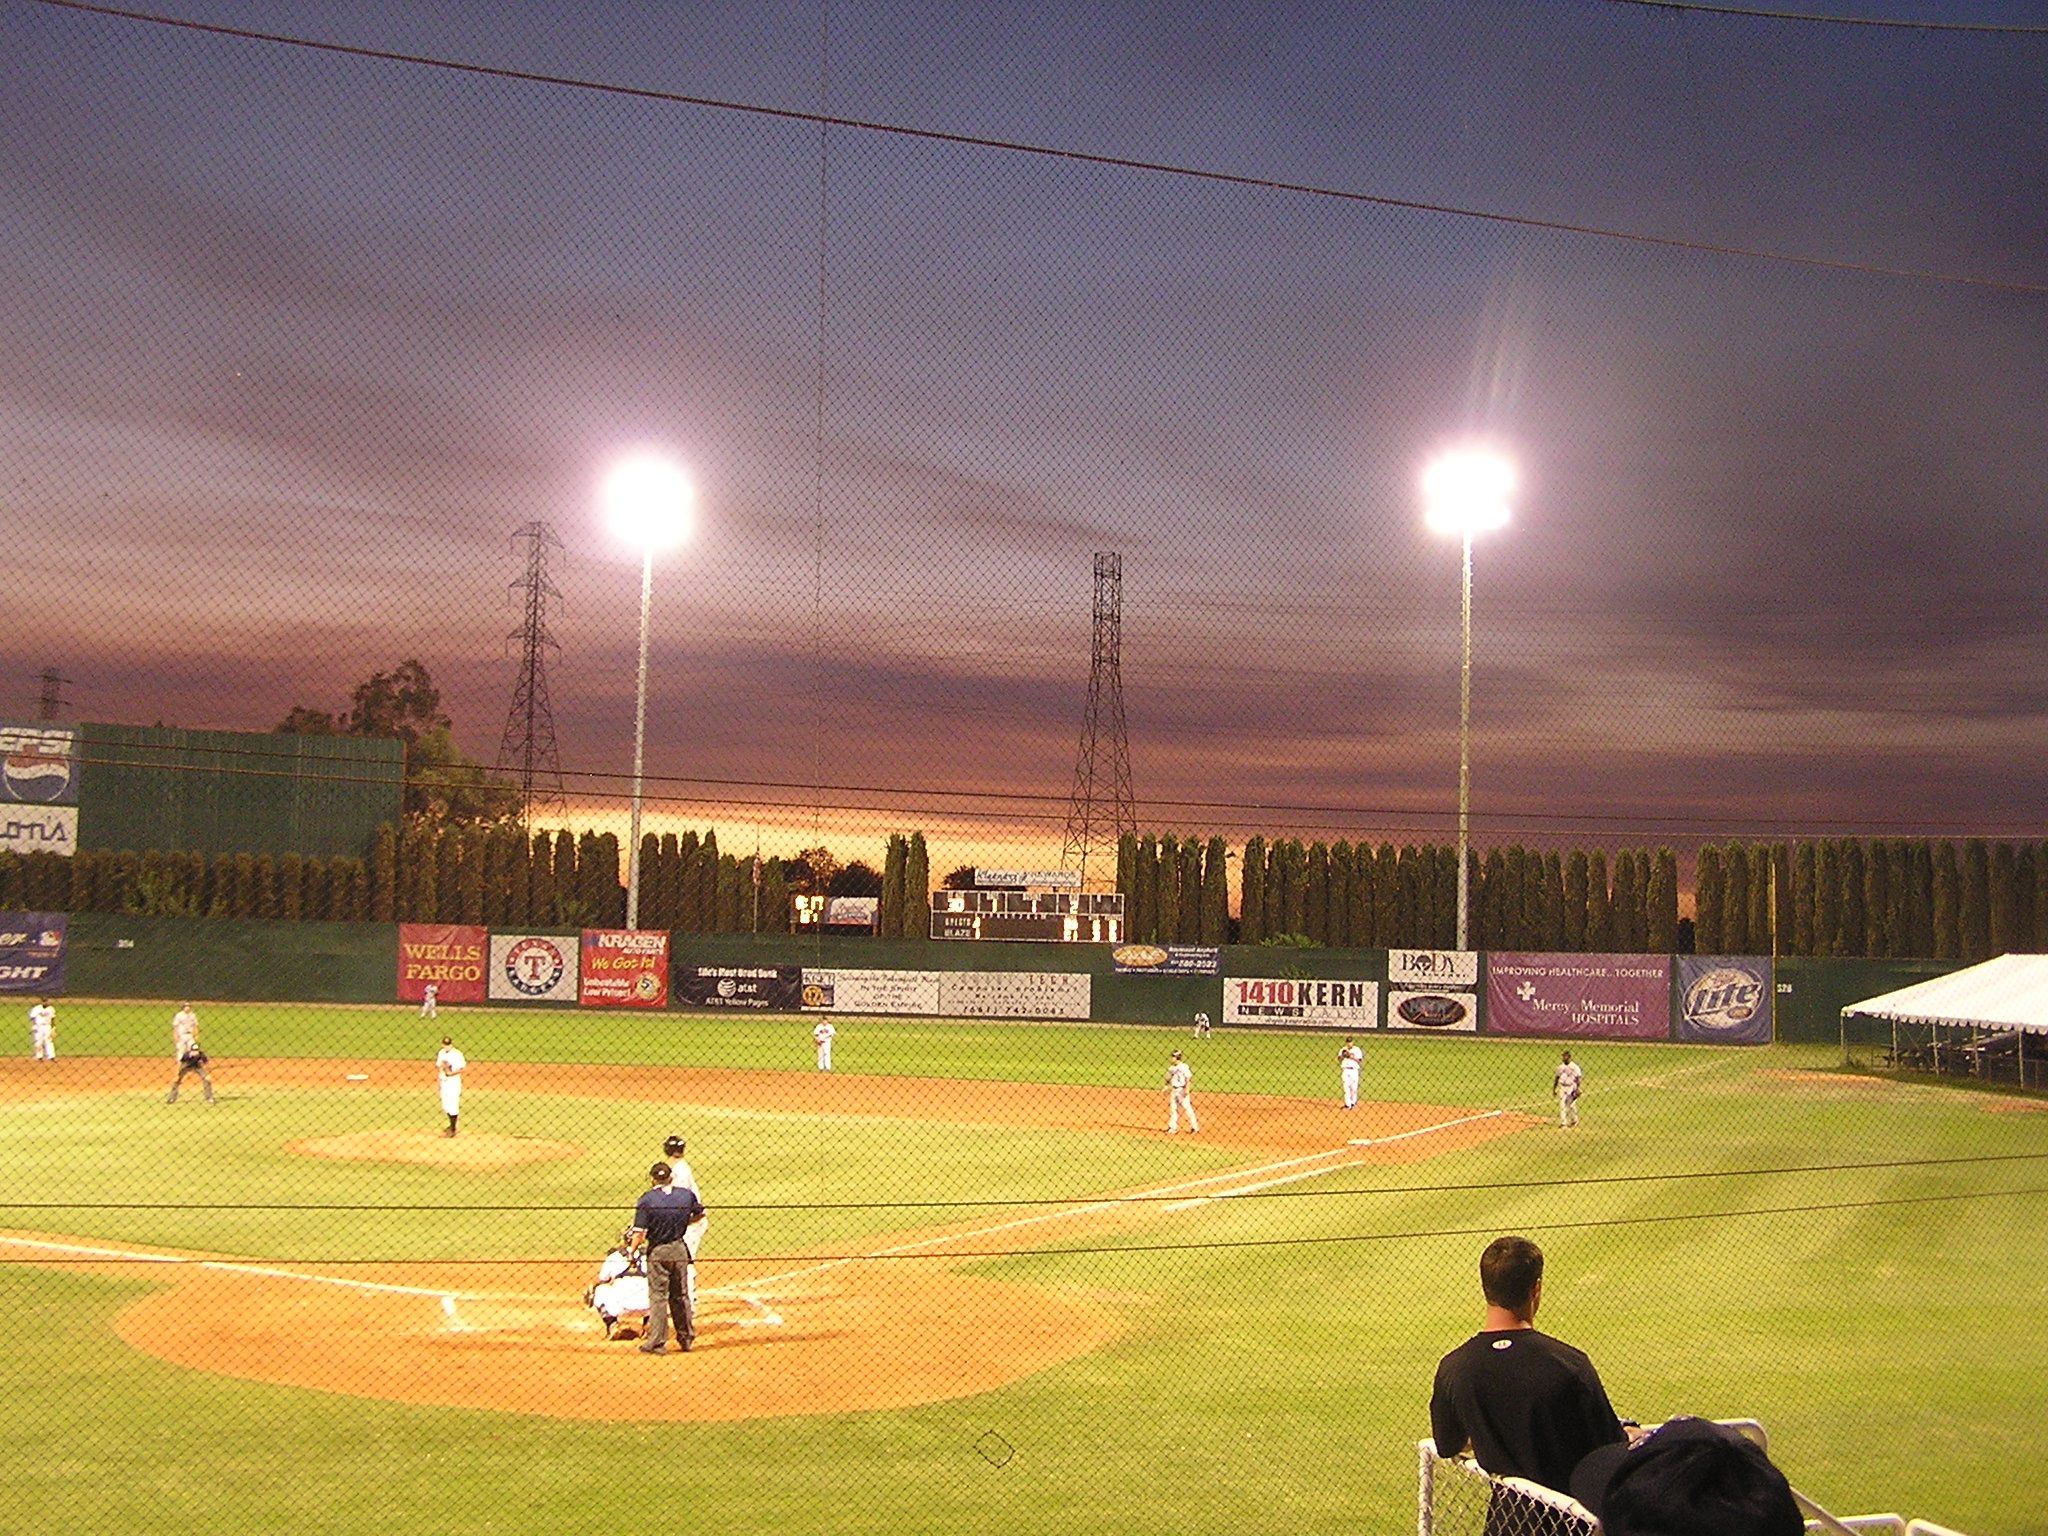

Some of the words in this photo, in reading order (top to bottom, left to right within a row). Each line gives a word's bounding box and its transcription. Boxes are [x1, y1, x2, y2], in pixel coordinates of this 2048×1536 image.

[598, 933, 666, 948] KRAGEN
[404, 943, 481, 961] WELLS
[524, 955, 546, 980] T
[592, 957, 609, 969] We
[612, 957, 638, 970] Got
[1402, 953, 1455, 972] BODY
[405, 964, 481, 981] FARGO
[1493, 967, 1546, 976] IMPROVING
[1615, 969, 1663, 978] TOGETHER
[1236, 981, 1294, 1004] 1410
[1298, 983, 1363, 1007] KERN
[1689, 983, 1761, 1018] Lite
[748, 998, 768, 1008] Pages
[1533, 999, 1570, 1014] Mercy
[1581, 999, 1639, 1012] Memorial
[1242, 1008, 1299, 1016] NEWS
[1572, 1013, 1639, 1025] HOSPITALS
